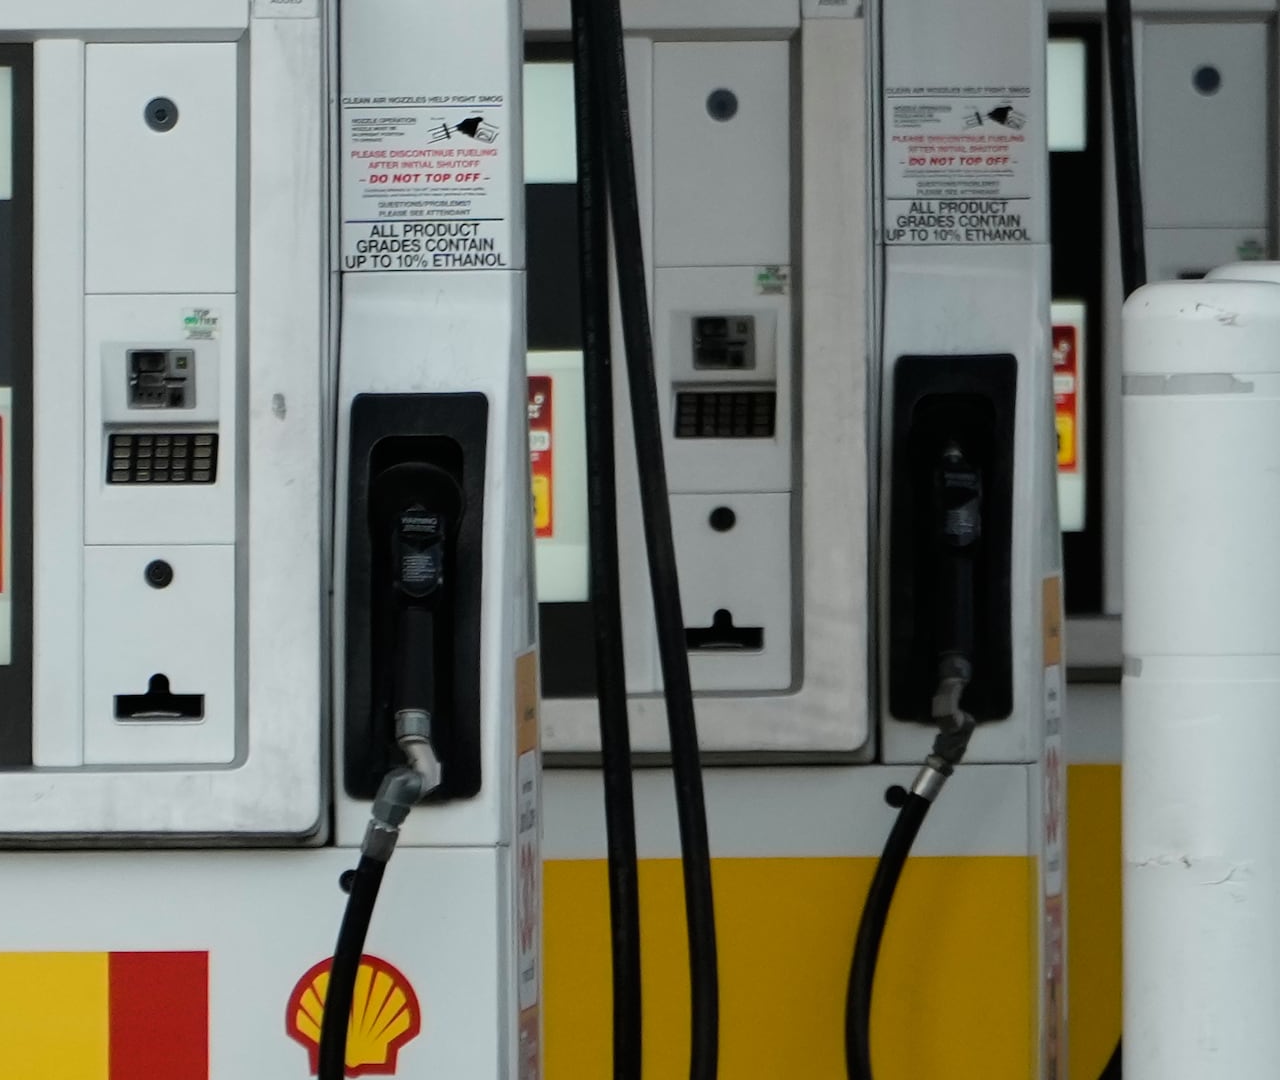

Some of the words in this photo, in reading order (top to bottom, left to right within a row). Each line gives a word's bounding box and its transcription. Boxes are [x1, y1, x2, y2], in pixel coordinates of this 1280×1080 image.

[390, 150, 453, 158] DISCONTINUE
[457, 149, 498, 157] FUELING
[368, 161, 399, 169] AFTER
[402, 161, 433, 169] INITIAL
[436, 160, 480, 168] SHUTOFF
[909, 157, 926, 166] DO
[930, 157, 955, 166] NOT
[959, 157, 982, 166] TOP
[986, 157, 1009, 166] OFF
[369, 175, 387, 183] DO
[392, 174, 420, 183] NOT
[425, 173, 451, 182] TOP
[455, 173, 481, 182] OFF
[909, 202, 935, 214] ALL
[939, 202, 1009, 214] PRODUCT
[896, 215, 955, 228] GRADES
[958, 215, 1020, 228] CONTAIN
[370, 225, 399, 238] ALL
[403, 223, 480, 237] PRODUCT
[886, 229, 906, 241] UP
[911, 229, 928, 241] TO
[934, 229, 961, 241] 10%
[965, 229, 1030, 241] ETHANOL
[356, 239, 421, 253] GRADES
[425, 238, 494, 252] CONTAIN
[345, 255, 368, 268] UP
[371, 255, 392, 267] TO
[397, 254, 428, 267] 10%
[433, 253, 506, 267] ETHANOL
